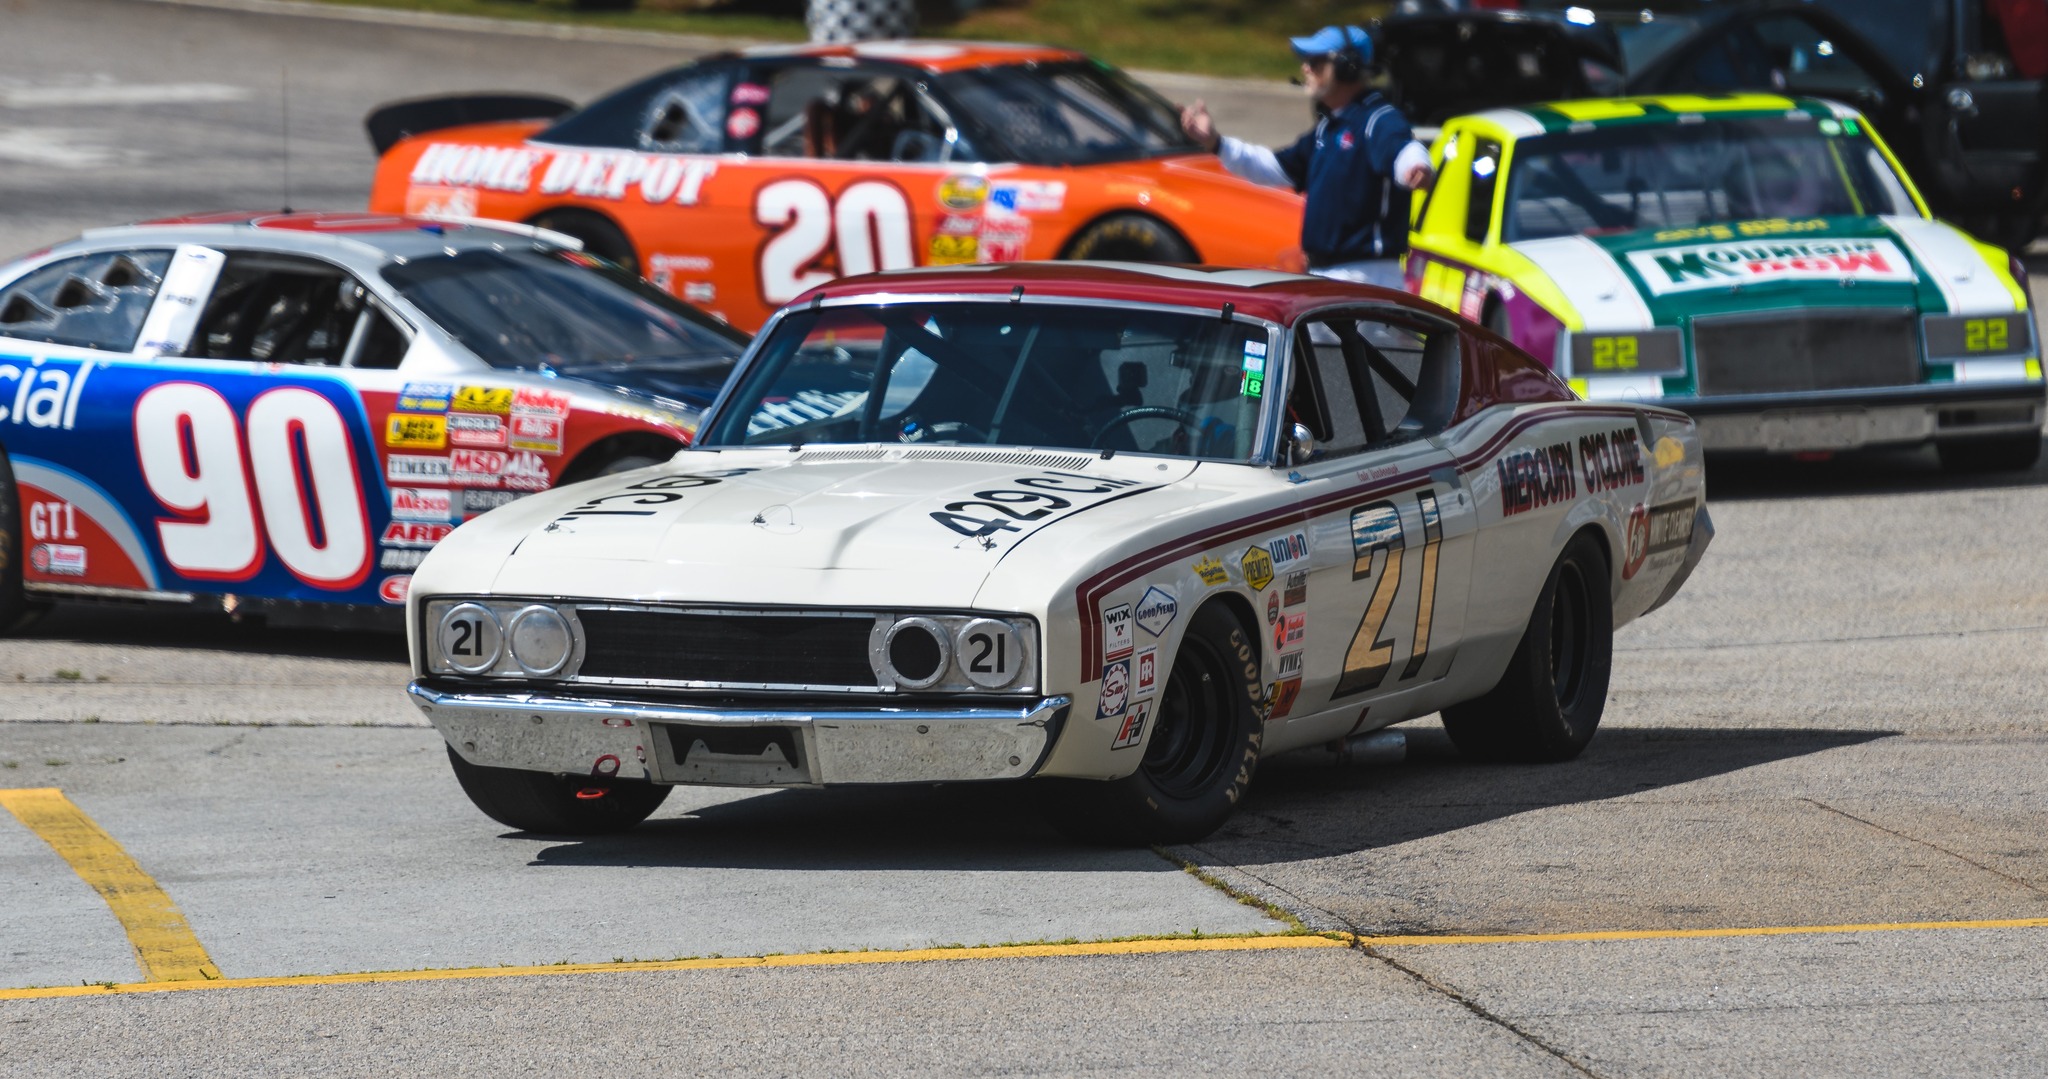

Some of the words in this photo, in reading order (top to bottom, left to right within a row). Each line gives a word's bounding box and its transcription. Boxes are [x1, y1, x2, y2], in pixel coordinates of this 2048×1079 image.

[411, 143, 546, 193] HOME
[539, 150, 718, 205] DEPOT
[756, 179, 914, 305] 20
[1592, 337, 1638, 369] 22
[1964, 319, 2009, 352] 22
[451, 452, 503, 473] MSD
[1497, 441, 1576, 517] MERCURY
[1579, 427, 1645, 494] CYCLONE
[135, 382, 371, 588] 90
[30, 501, 78, 540] GT1
[929, 489, 1072, 537] 429
[1245, 556, 1271, 580] PREMIER
[1329, 488, 1443, 701] 21
[1106, 608, 1131, 624] WIX
[451, 620, 483, 656] 21
[970, 632, 1006, 674] 21
[1109, 638, 1130, 648] FILTERS
